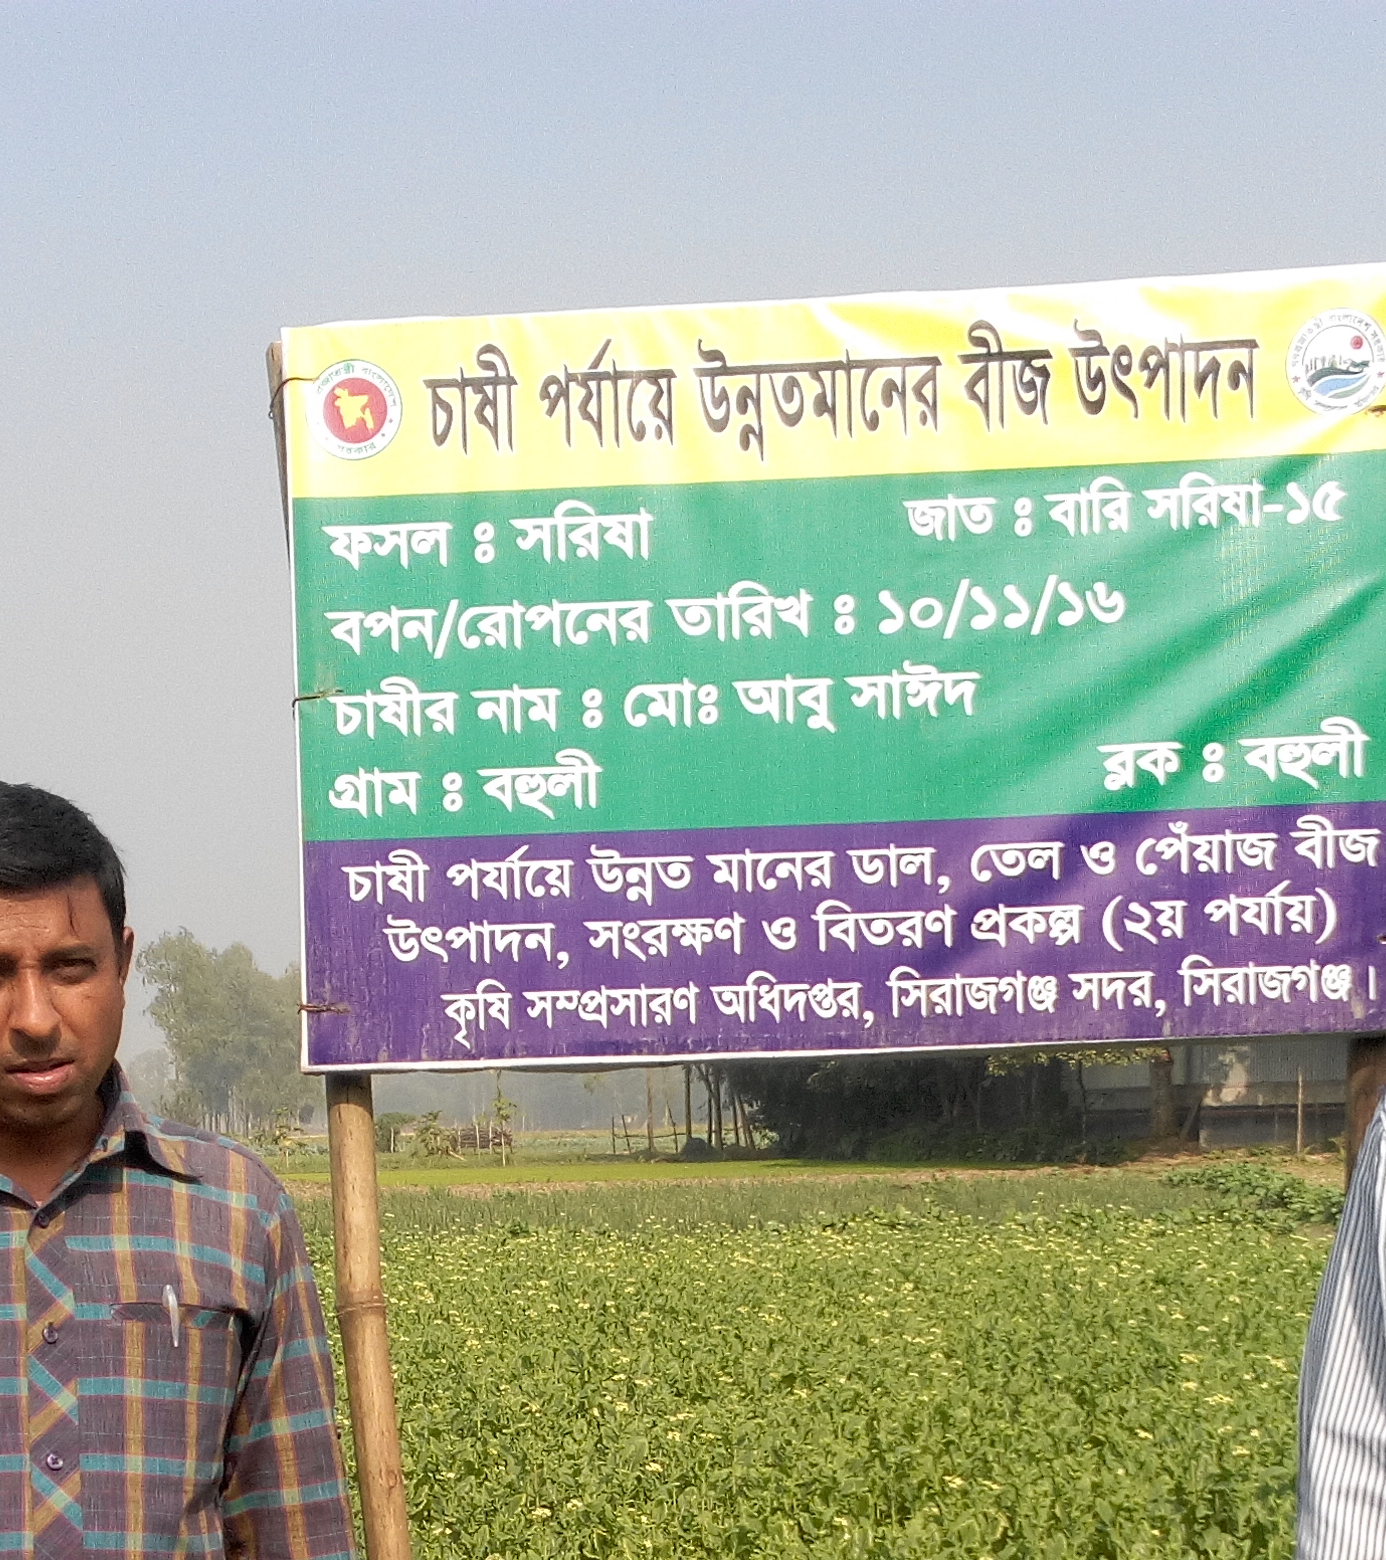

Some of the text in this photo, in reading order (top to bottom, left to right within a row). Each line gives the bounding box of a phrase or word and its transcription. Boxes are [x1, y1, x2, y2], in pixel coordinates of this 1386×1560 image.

[423, 318, 1260, 462] চাষী পর্যায়ে উন্নতমানের বীজ উৎপাদন
[322, 520, 453, 571] ফসল
[510, 501, 654, 562] সরিষা
[904, 494, 997, 541] জাত
[1044, 476, 1133, 537] বারি
[1143, 472, 1347, 534] সরিষা-১৫
[324, 599, 654, 659] বপন/রোপনের
[666, 581, 813, 643] তারিখ
[878, 575, 1125, 639] ১০/১১/১৬
[330, 677, 456, 739] চাষীর
[471, 684, 562, 733] নাম
[733, 674, 837, 734] আবু
[846, 660, 980, 720] সাঈদ
[329, 768, 421, 818] গ্রাম
[477, 749, 603, 820] বহুলী
[1098, 741, 1184, 791] ব্লক
[1239, 716, 1371, 788] বহুলী
[343, 816, 1381, 906] চাষী পর্যায়ে উন্নত মানের ডাল, তেল ও পেঁয়াজ বীজ
[384, 880, 1338, 970] উৎপাদন, সংরক্ষণ ও বিতরণ প্রকল্প (২য় পর্যায়)
[442, 979, 512, 1049] কৃষি
[523, 981, 700, 1032] সম্প্রসারণ
[711, 971, 874, 1029] অধিদপ্তর,
[887, 966, 1059, 1019] সিরাজগঞ্জ
[1069, 970, 1167, 1018] সদর,
